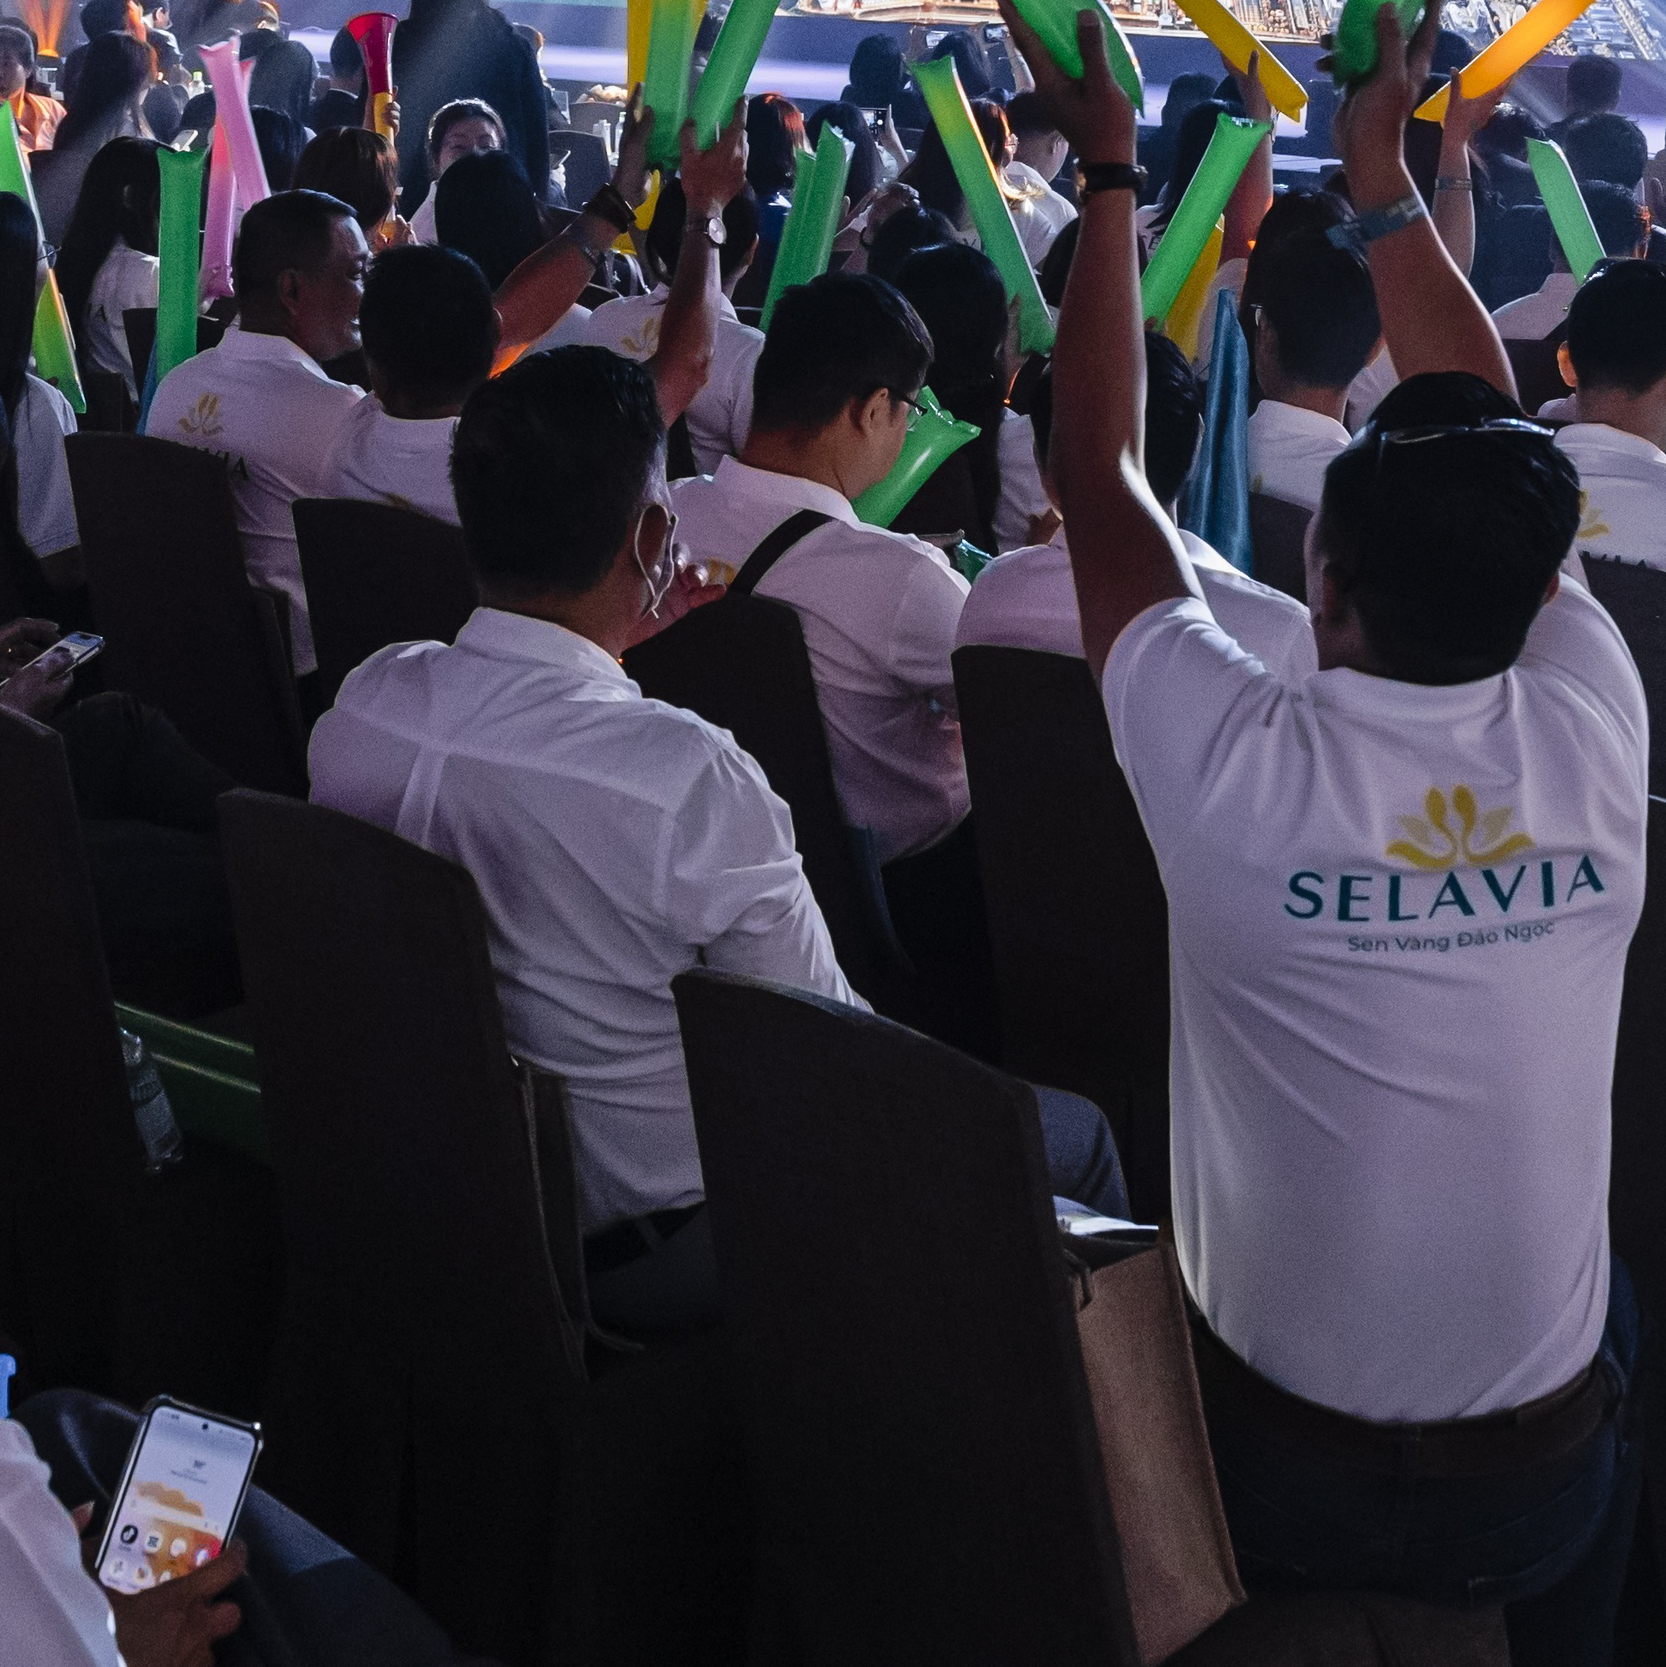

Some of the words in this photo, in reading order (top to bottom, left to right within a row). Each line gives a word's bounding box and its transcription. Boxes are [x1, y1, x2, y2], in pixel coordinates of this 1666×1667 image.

[1283, 854, 1606, 922] SELAVIA
[1347, 934, 1389, 953] Sen
[1395, 933, 1450, 954] Vàng
[1457, 927, 1499, 949] Đảo
[1504, 920, 1556, 942] Ngọc
